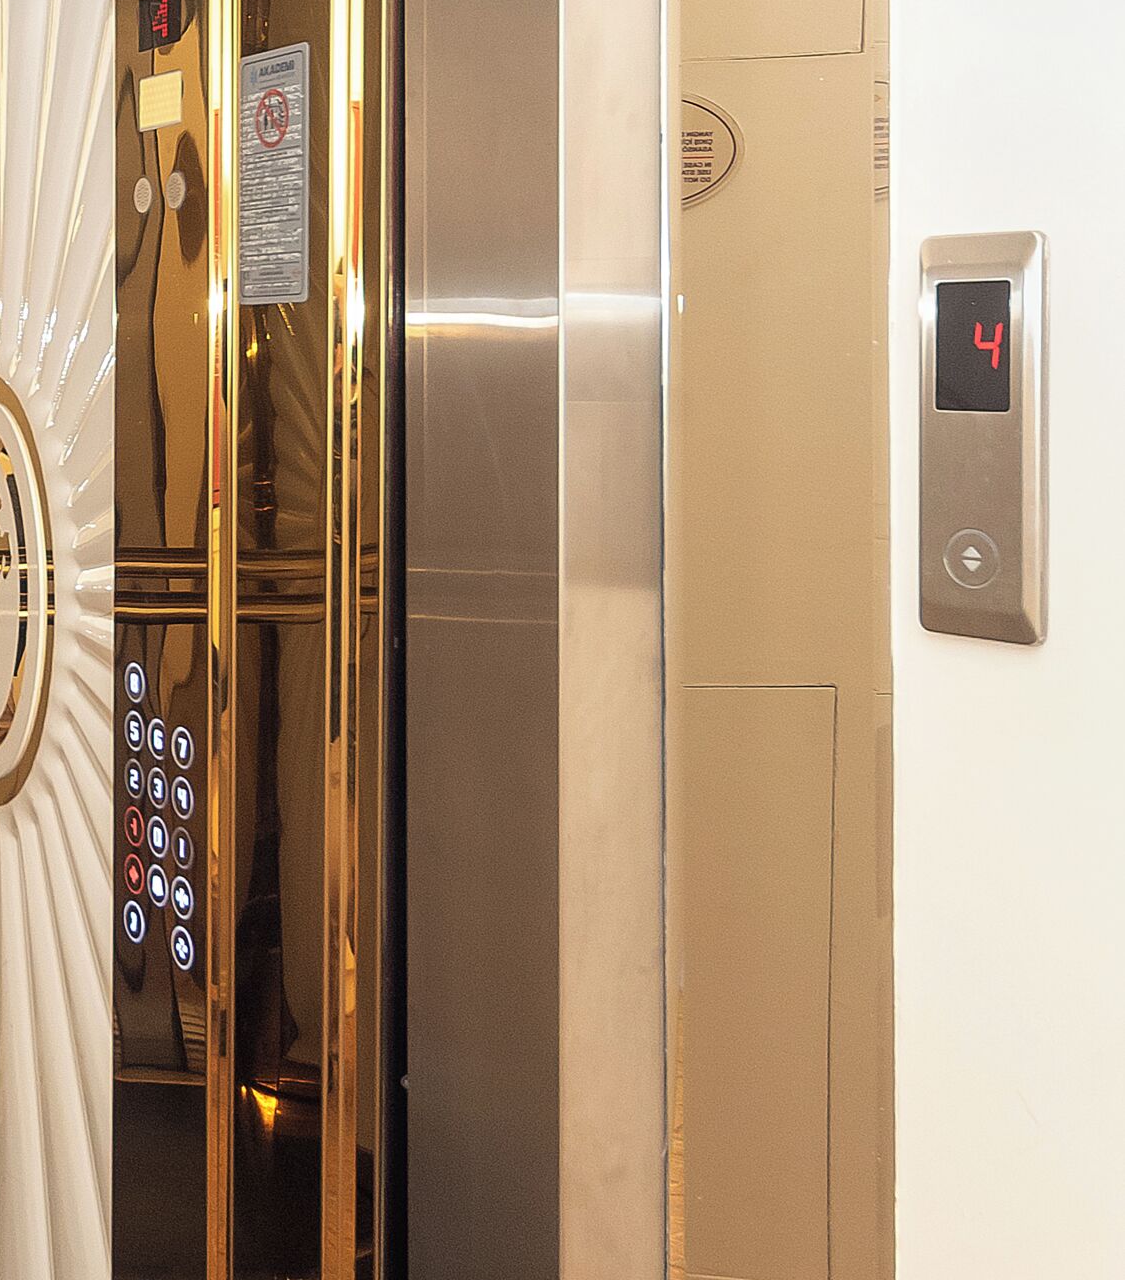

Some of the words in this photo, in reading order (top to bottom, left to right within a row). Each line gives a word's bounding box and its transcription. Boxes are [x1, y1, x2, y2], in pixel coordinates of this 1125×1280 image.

[974, 322, 1003, 370] 4
[129, 720, 140, 742] 5
[153, 728, 164, 751] 6
[177, 737, 188, 759] 7
[129, 768, 139, 790] 2
[153, 777, 163, 799] 3
